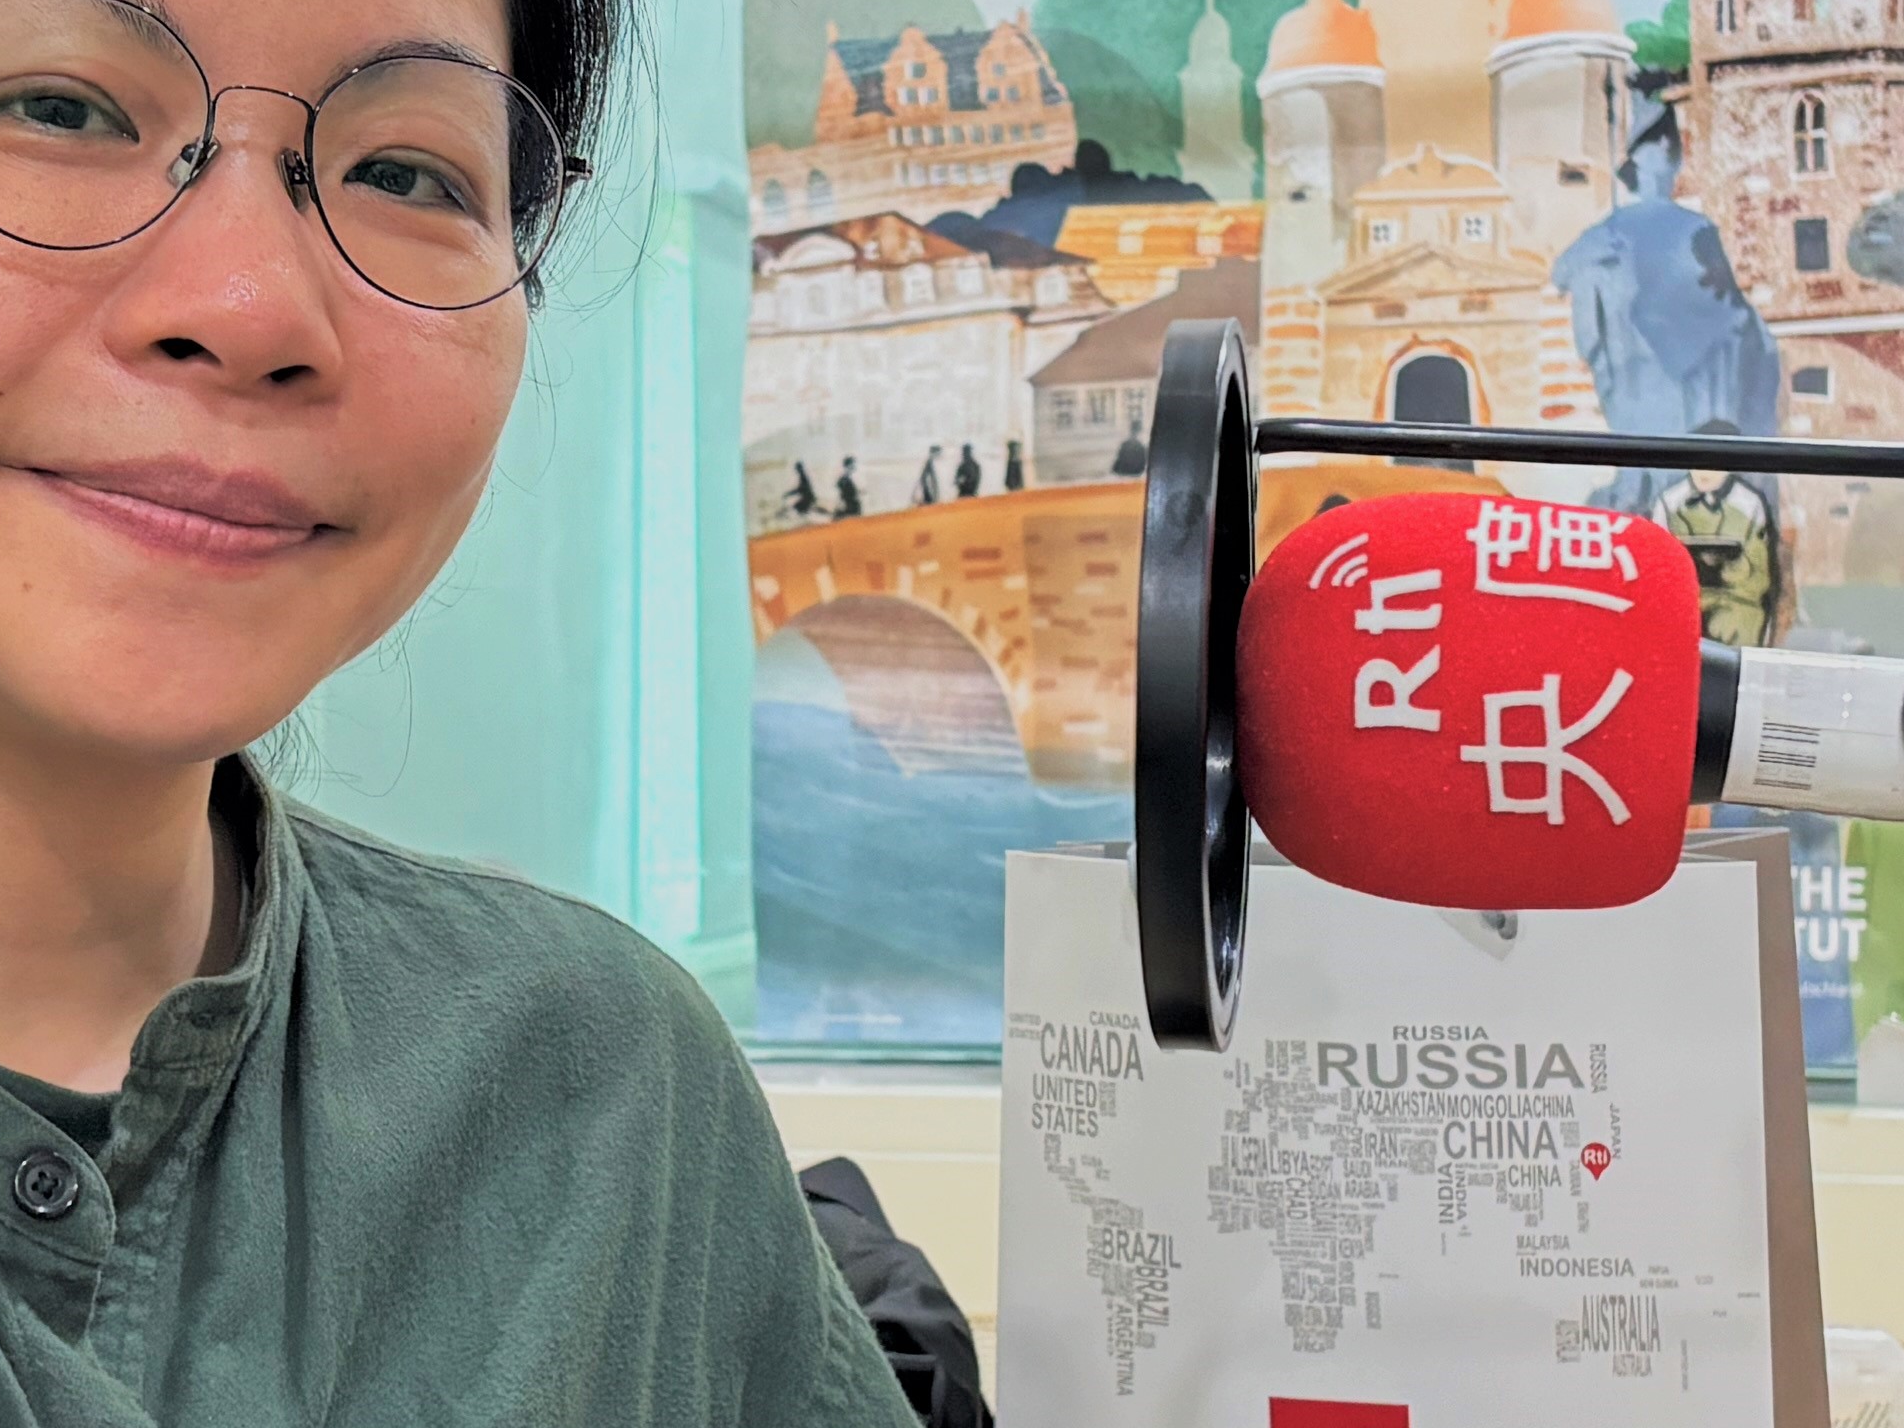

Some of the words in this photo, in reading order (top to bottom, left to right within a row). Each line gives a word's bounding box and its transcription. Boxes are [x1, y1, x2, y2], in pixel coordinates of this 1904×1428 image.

[1460, 498, 1636, 826] 央廣
[1790, 865, 1868, 912] HE
[1089, 1011, 1142, 1031] CANADA
[1392, 1024, 1490, 1042] RUSSIA
[1040, 1021, 1145, 1082] CANADA
[1316, 1040, 1586, 1091] RUSSIA
[1032, 1072, 1097, 1109] UNITED
[1355, 1089, 1446, 1118] KAZAKHSTAN
[1446, 1093, 1533, 1120] MONGOLIA
[1533, 1093, 1576, 1119] CHINA
[1031, 1102, 1099, 1139] STATES
[1442, 1119, 1559, 1161] CHINA
[1608, 1102, 1622, 1160] JAPAN
[1437, 1161, 1455, 1225] INDIA
[1454, 1164, 1469, 1222] INDIA
[1100, 1226, 1183, 1270] BRAZIL
[1519, 1257, 1636, 1279] INDONESIA
[1579, 1294, 1661, 1353] AUSTRALIA
